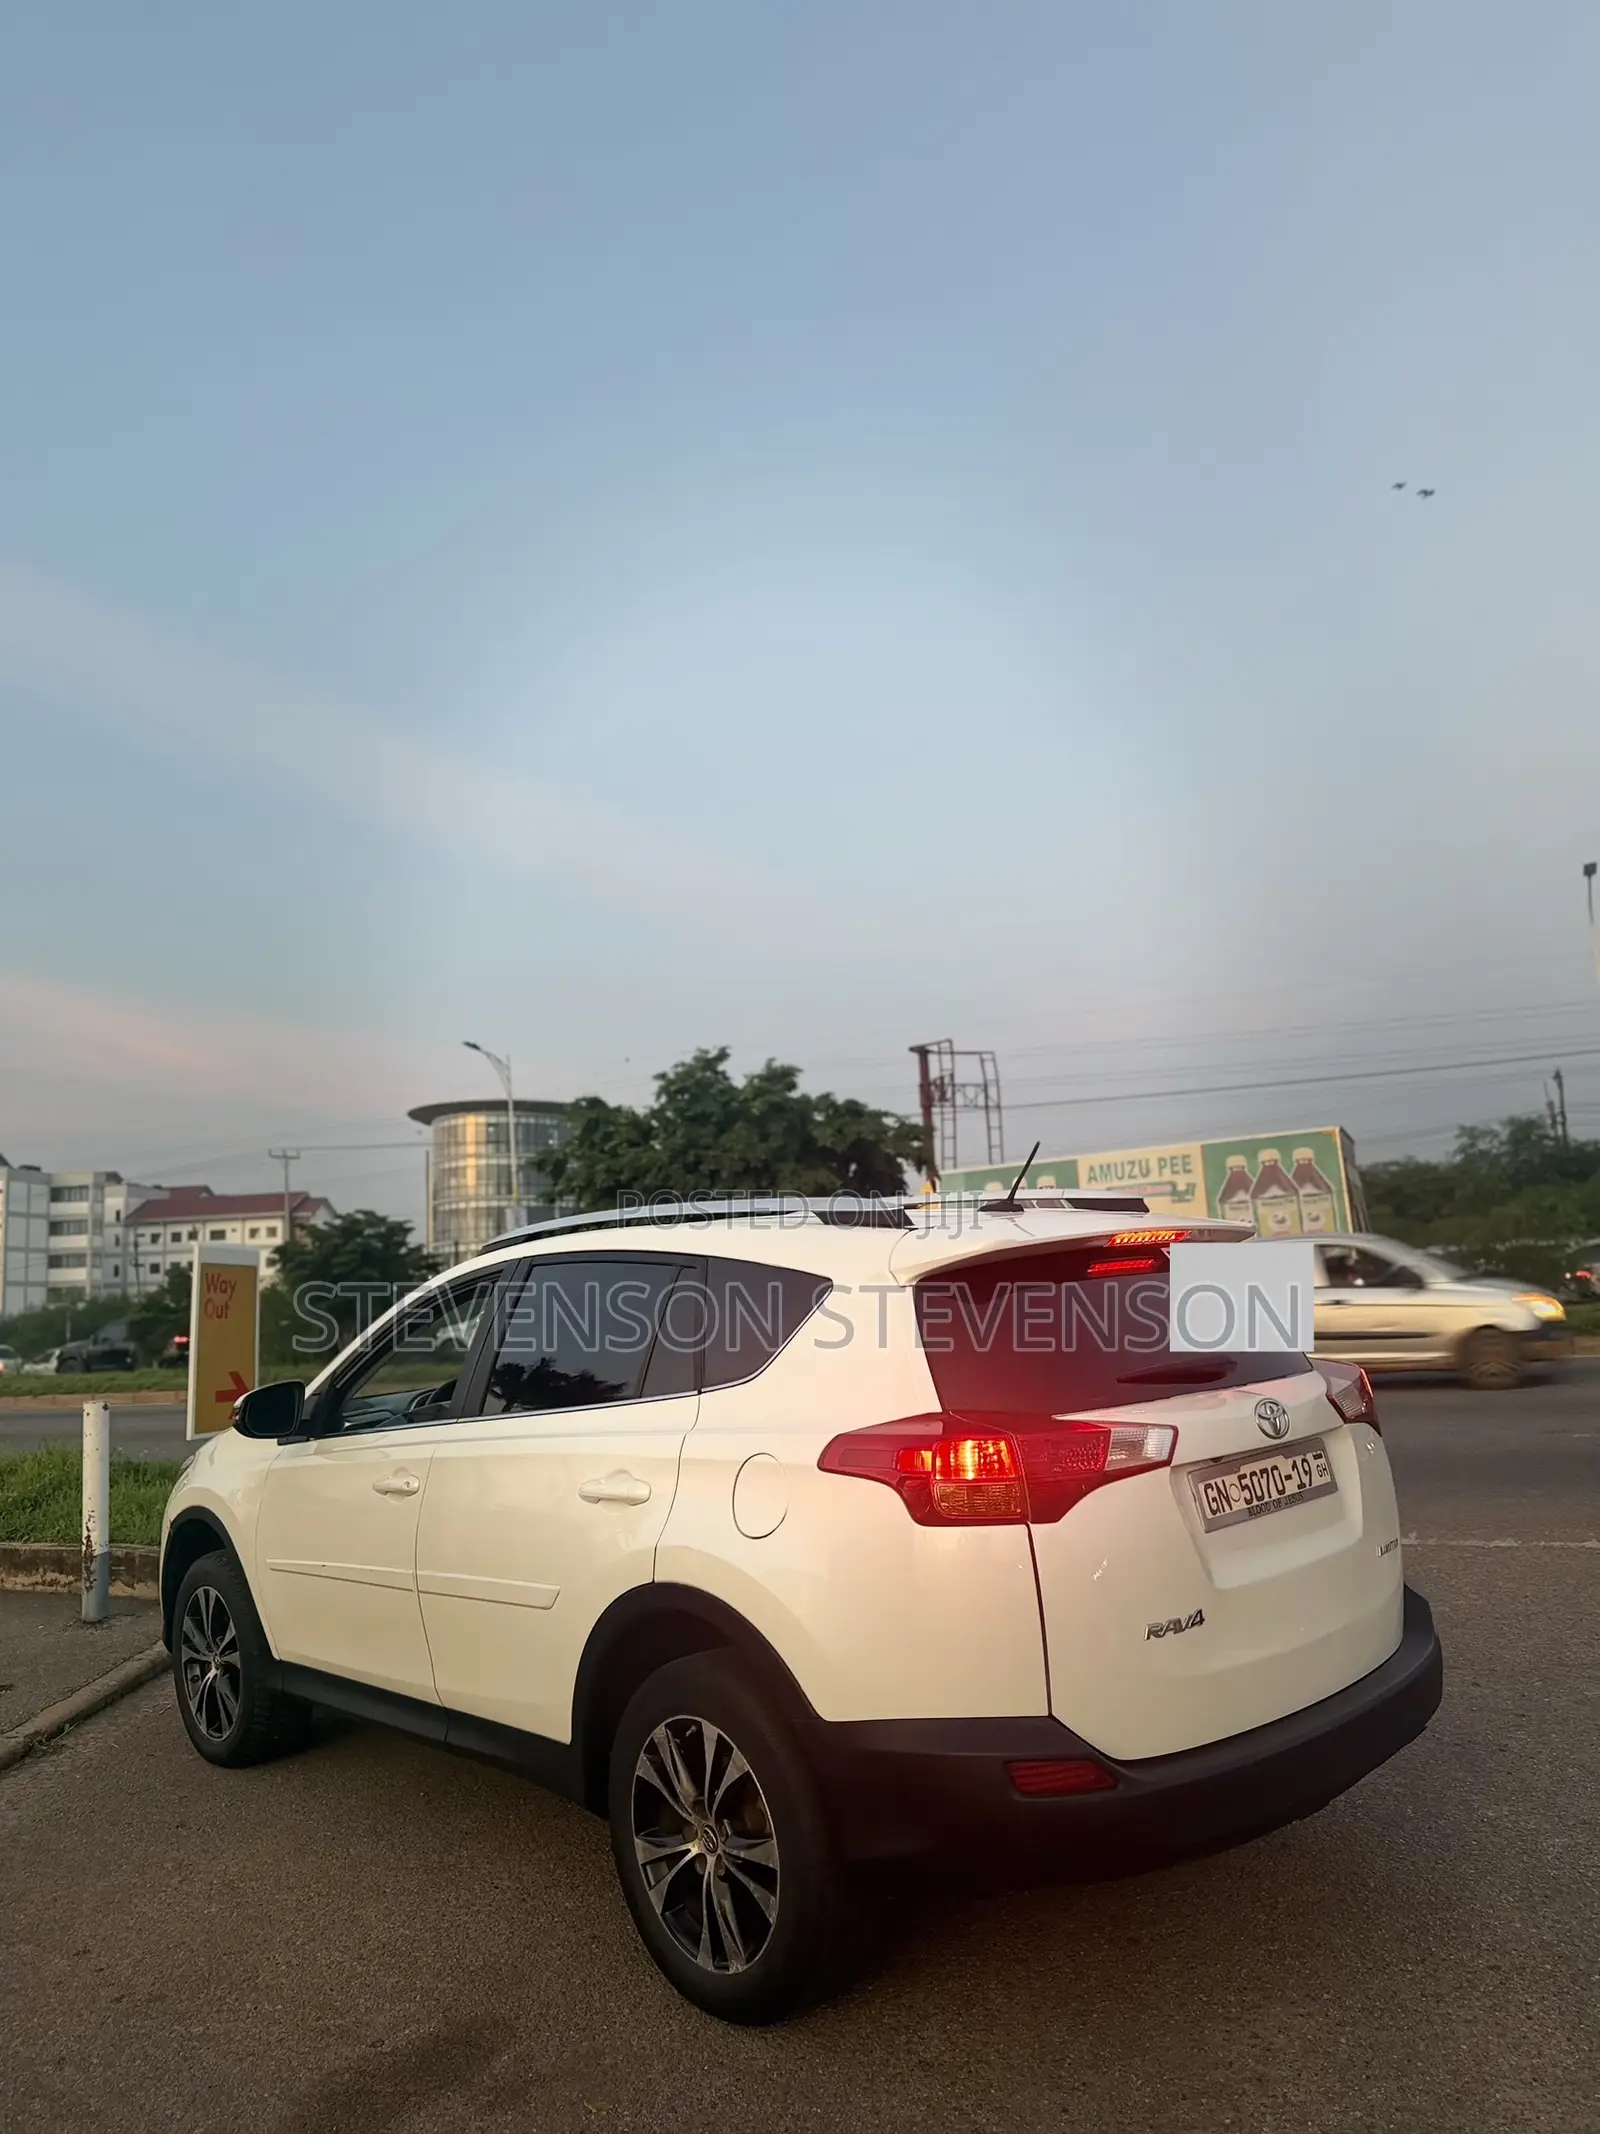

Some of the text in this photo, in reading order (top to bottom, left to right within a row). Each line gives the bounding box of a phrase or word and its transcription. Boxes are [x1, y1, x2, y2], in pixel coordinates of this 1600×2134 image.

[1087, 1154, 1193, 1184] AMUZU PEE
[205, 1272, 238, 1299] Way
[204, 1300, 230, 1320] Out
[1237, 1458, 1313, 1506] 5070-19
[1316, 1462, 1329, 1478] GH
[1247, 1502, 1271, 1517] BLOOD
[1272, 1498, 1283, 1510] OF
[1143, 1609, 1205, 1641] RAV4
